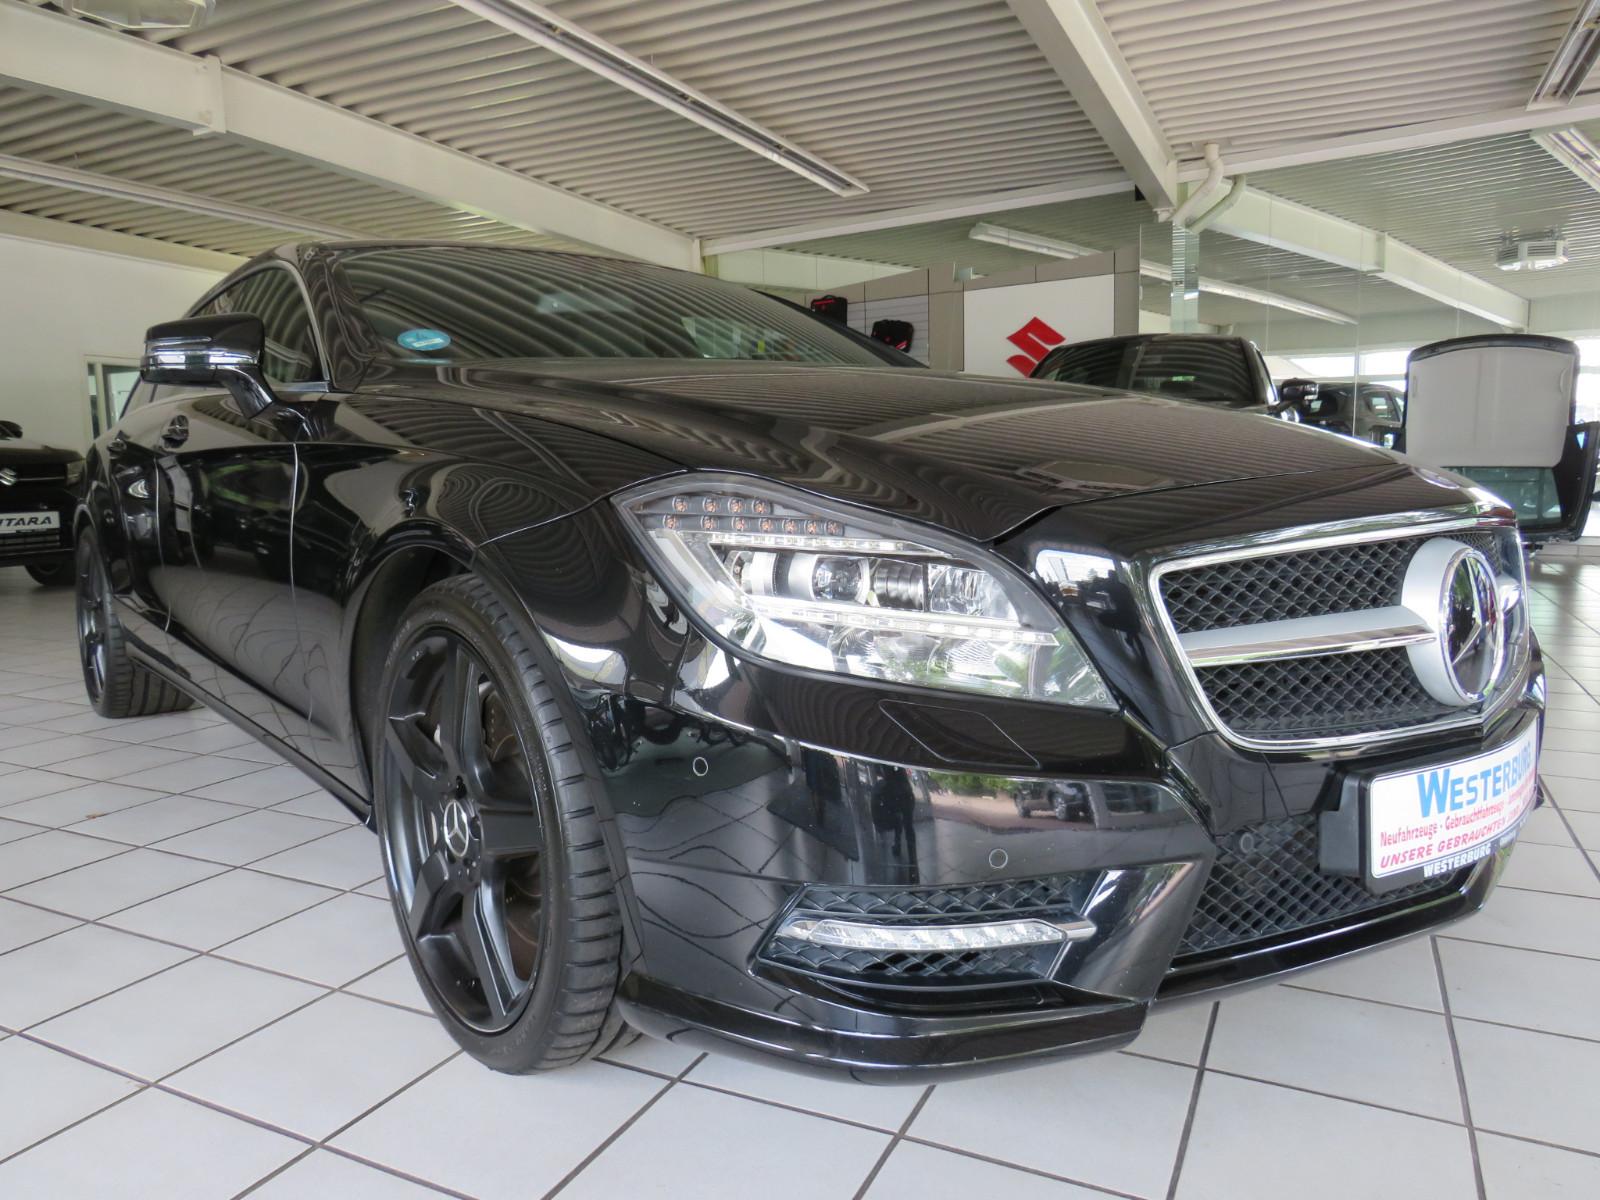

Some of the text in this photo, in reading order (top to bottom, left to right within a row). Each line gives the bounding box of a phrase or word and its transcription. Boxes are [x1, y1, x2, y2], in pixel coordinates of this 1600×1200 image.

[0, 516, 52, 527] ITARA
[1380, 824, 1438, 847] Neufahrzeuge
[1380, 844, 1433, 868] UNSERE
[1423, 842, 1491, 878] WESTERBURG
